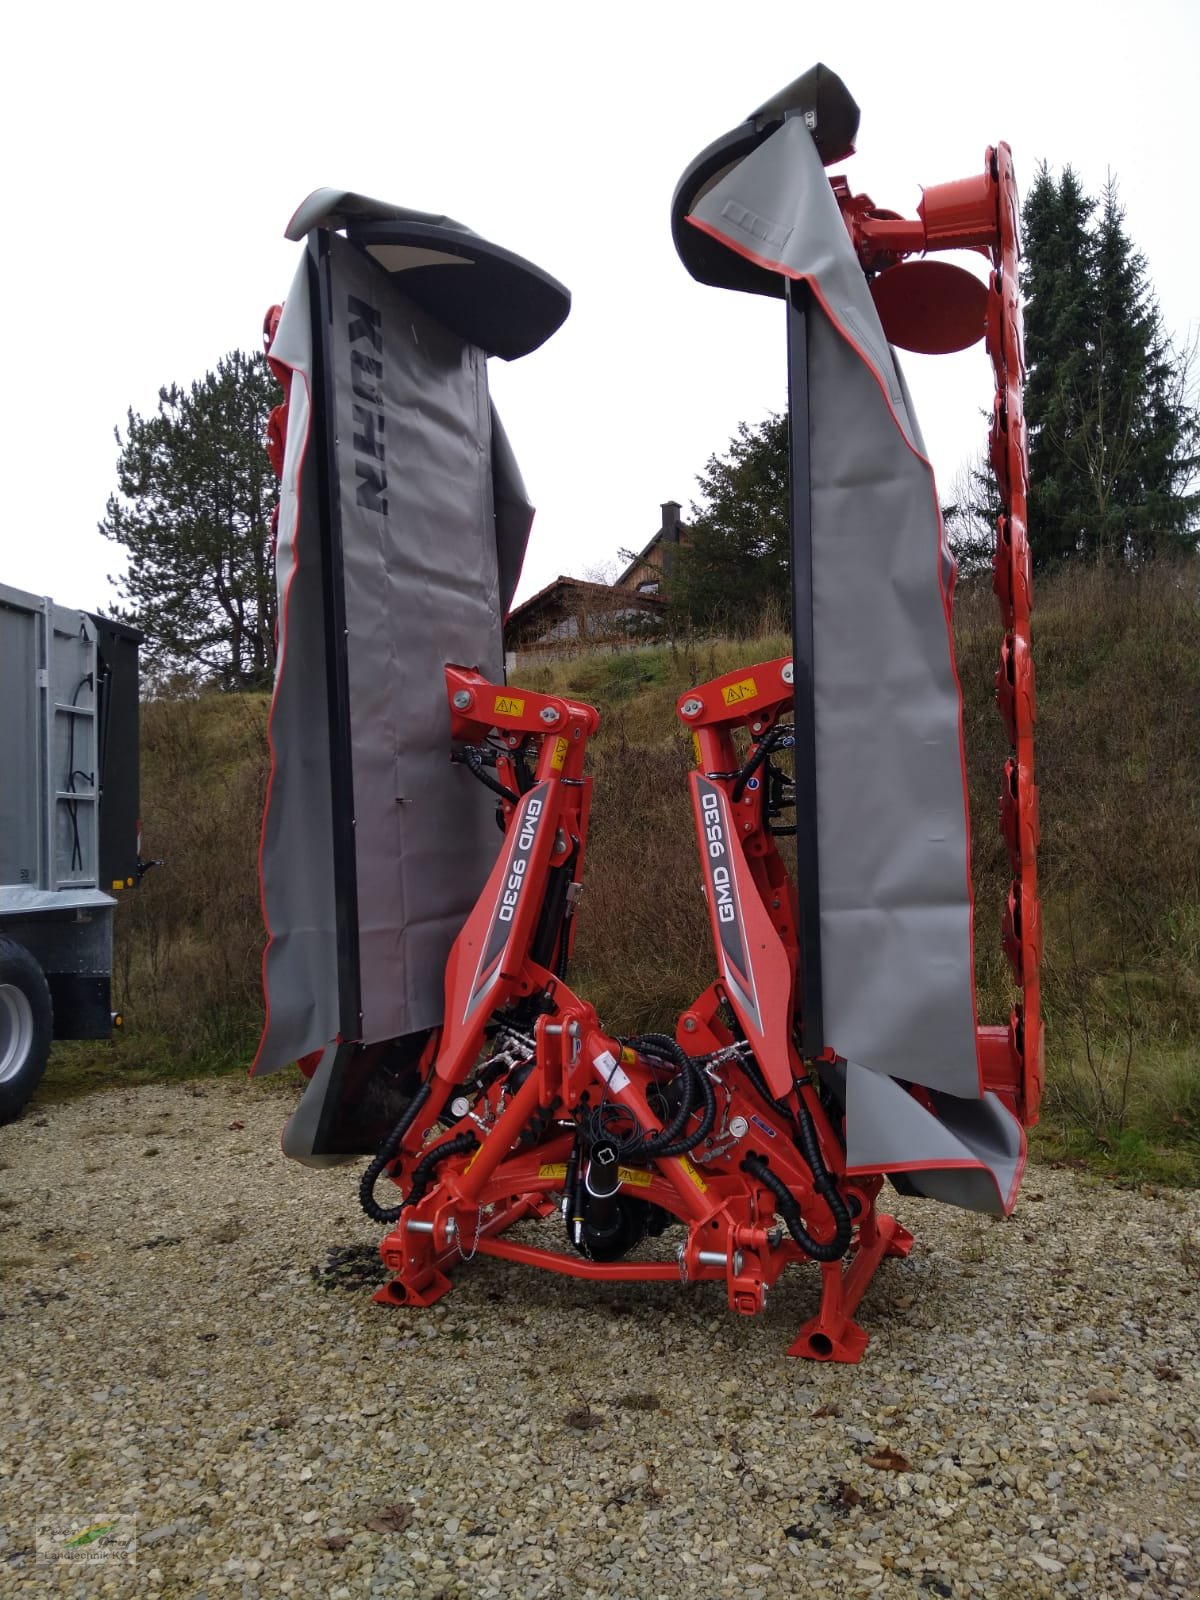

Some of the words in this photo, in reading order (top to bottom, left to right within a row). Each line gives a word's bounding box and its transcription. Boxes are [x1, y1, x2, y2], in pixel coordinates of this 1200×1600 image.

[347, 294, 389, 516] KUHN
[518, 798, 542, 851] GMD
[702, 793, 725, 858] 9530
[498, 859, 527, 922] 9530
[713, 866, 735, 923] GMD
